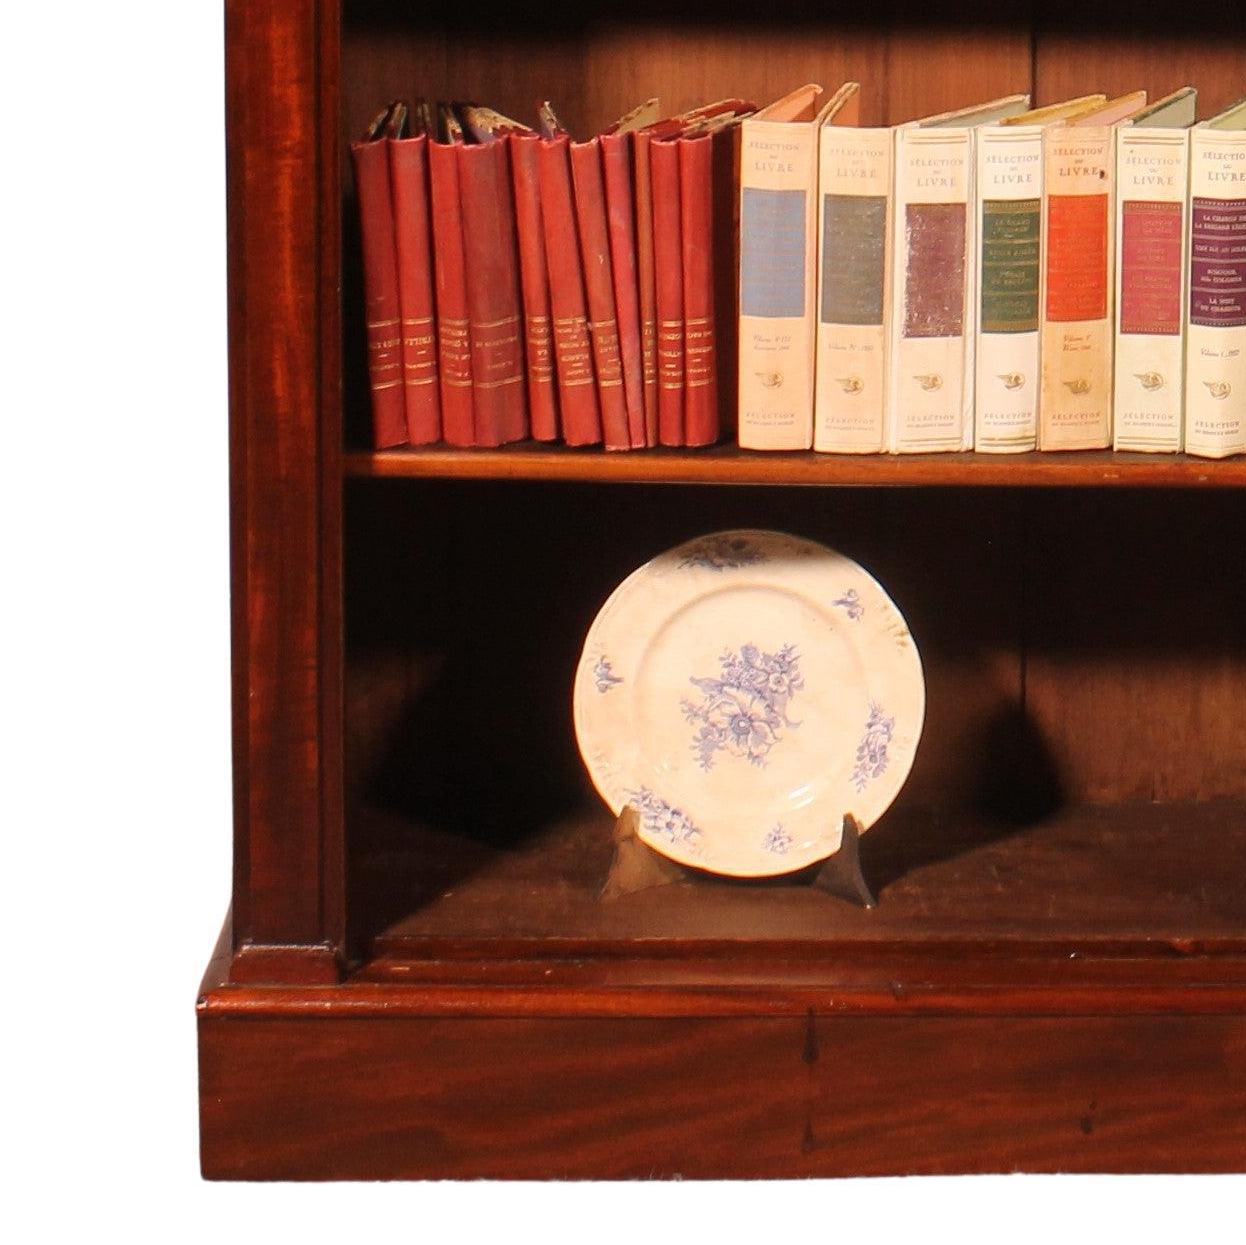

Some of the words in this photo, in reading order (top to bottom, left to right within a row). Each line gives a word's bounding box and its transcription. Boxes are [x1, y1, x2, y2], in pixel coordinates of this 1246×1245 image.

[754, 161, 794, 173] LIVRE
[1059, 166, 1098, 177] LIVRE
[836, 168, 878, 179] LIVRE
[993, 173, 1033, 185] LIVRE
[1207, 171, 1246, 182] LIVRE
[917, 177, 957, 188] LIVRE
[1133, 175, 1174, 186] LIVRE
